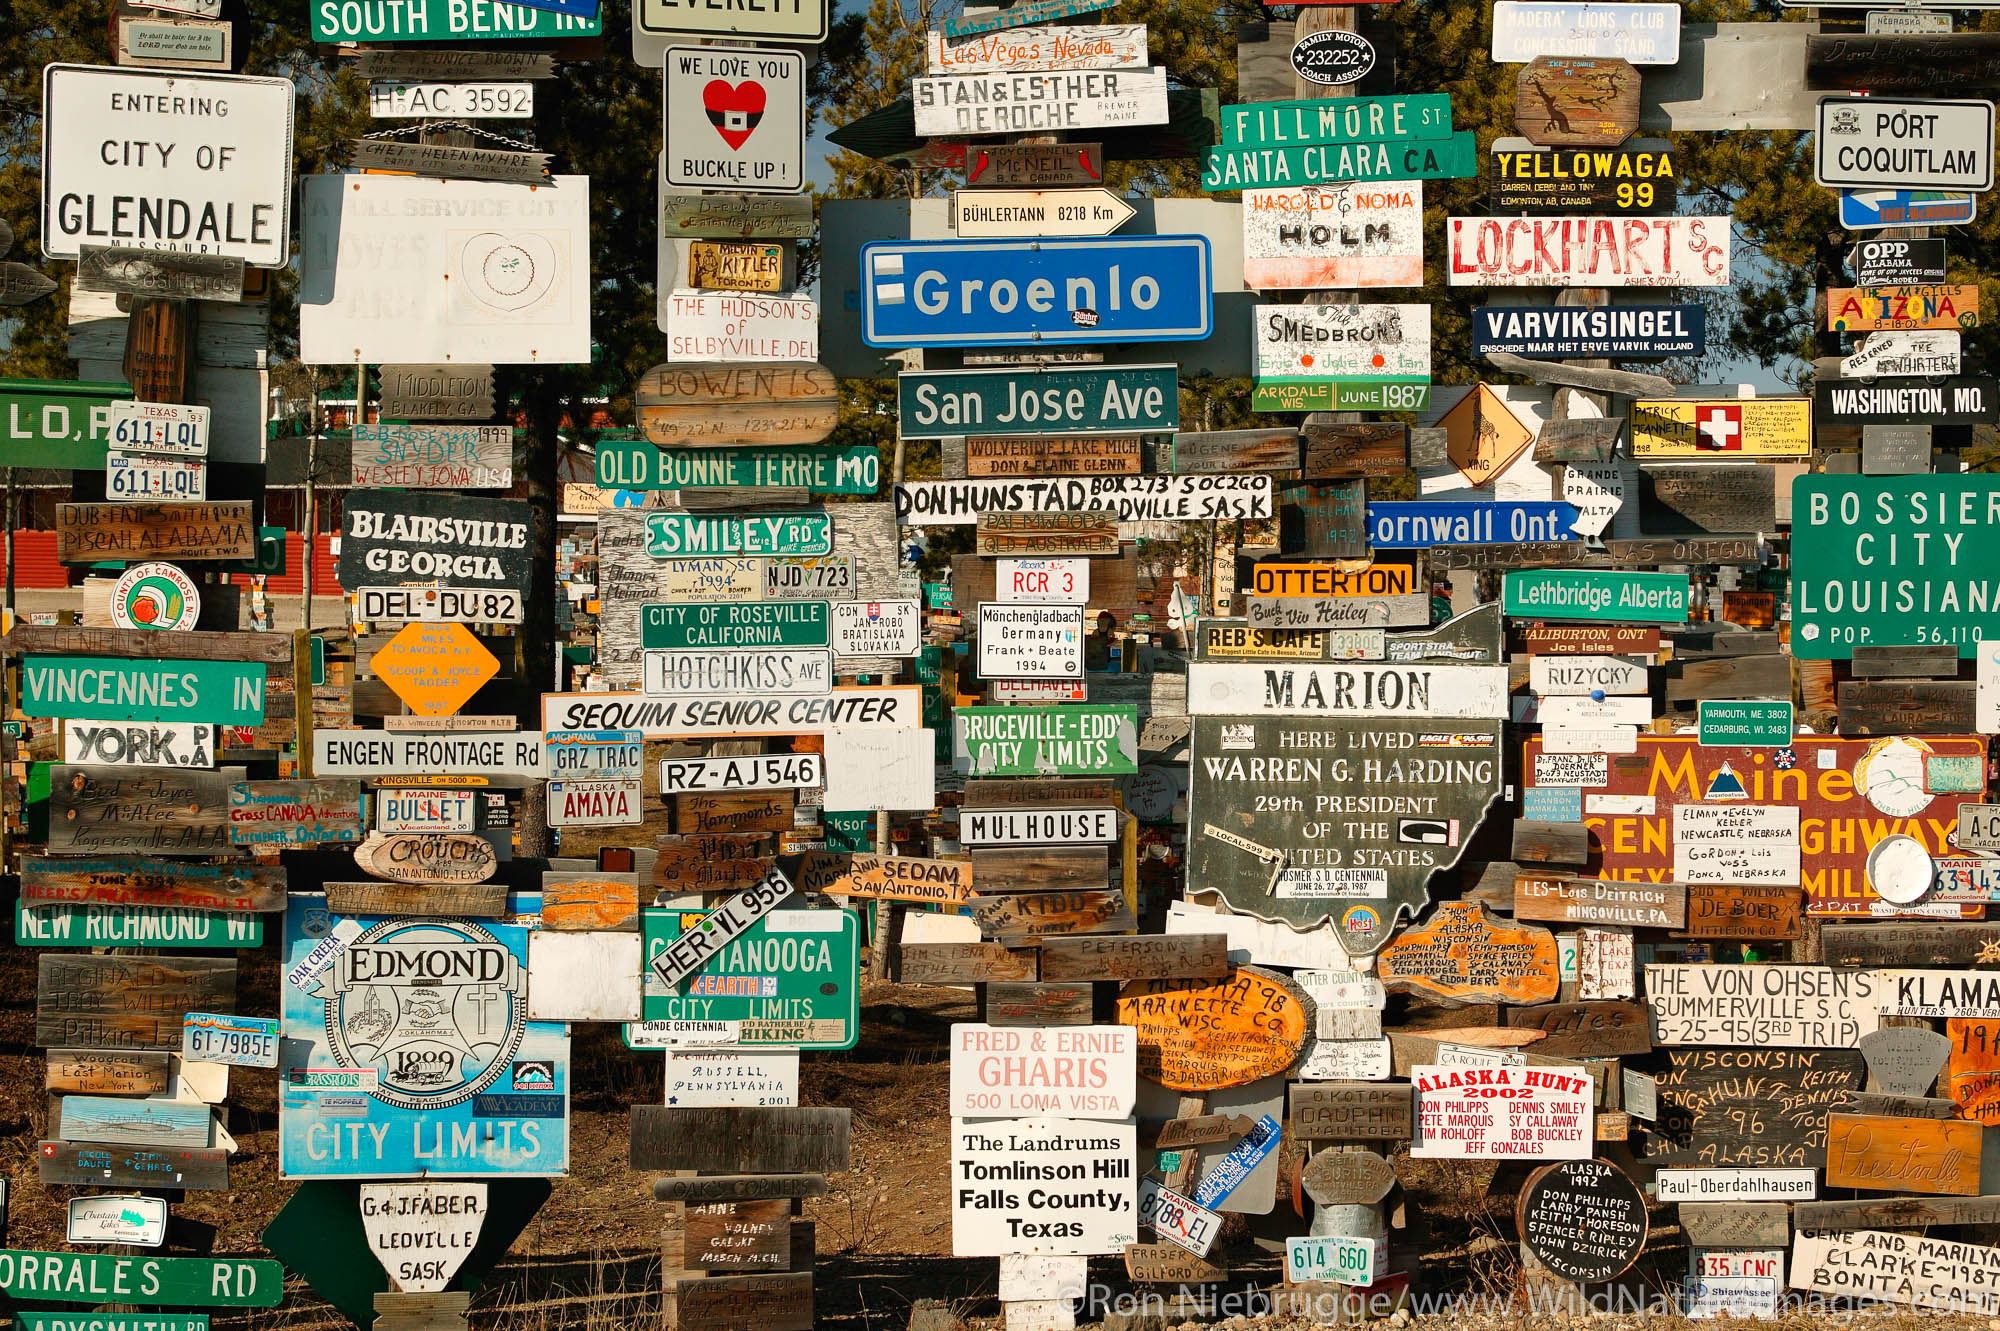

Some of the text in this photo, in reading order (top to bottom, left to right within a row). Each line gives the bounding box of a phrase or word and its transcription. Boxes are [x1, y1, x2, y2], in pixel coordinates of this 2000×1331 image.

[1877, 17, 1921, 26] NEBRASKA
[1298, 33, 1367, 51] FAMILY MOTOR
[680, 57, 790, 79] WE LOVE YOU
[1306, 50, 1360, 66] 232252
[1300, 65, 1367, 82] COACH ASSOC.
[112, 93, 229, 118] ENTERING
[1876, 114, 1938, 139] PORT
[100, 139, 236, 171] CITY OF
[1207, 144, 1440, 186] SANTA CLARA CA
[1838, 146, 1976, 174] COQUITLAM
[683, 159, 747, 180] BUCKLE
[1497, 153, 1674, 179] YELLOWAGA
[1616, 183, 1654, 209] 99
[58, 193, 273, 244] GLENDALE
[963, 205, 1114, 222] BÜHLERTANN 8218 Km
[1863, 242, 1909, 259] OPP
[1863, 259, 1912, 268] ALABAMA
[914, 264, 1160, 315] Groenlo
[1487, 310, 1689, 338] VARVIKSINGEL
[1479, 341, 1694, 353] ENSCHEDE NAAR HET ERVE VARVIK HOLLAND
[143, 407, 178, 418] TEXAS
[915, 379, 1163, 425] San Jose Ave
[116, 419, 202, 448] 611 LQL
[350, 510, 527, 549] BLAIRSVILLE
[365, 548, 505, 580] GEORGIA
[768, 566, 849, 587] NJD 723
[1518, 579, 1683, 613] Lethbridge Alberta
[649, 604, 819, 626] CITY OF ROSEVILLE
[983, 609, 1081, 626] Mönchengladbach
[686, 626, 783, 645] CALIFORNIA
[1002, 626, 1062, 642] Germany
[1208, 629, 1321, 648] REB'S CAFE
[987, 645, 1075, 656] Frank Beate
[1549, 642, 1614, 652] Joe Isles
[662, 655, 822, 689] HOTCHKISS AVE
[1016, 661, 1046, 671] 1994
[1547, 667, 1634, 686] RUZYCKY
[27, 667, 261, 712] VINCENNES IN
[1264, 669, 1432, 711] MARION
[561, 696, 898, 730] SEQUIM SENIOR CENTER
[1704, 710, 1748, 720] YARMOUTH,
[1767, 710, 1787, 719] 3802
[1279, 731, 1415, 749] HERE LIVED
[1704, 725, 1750, 736] CEDARBURG,
[1768, 725, 1787, 734] 2483
[327, 741, 539, 766] ENGEN FRONTAGE Rd
[1202, 756, 1492, 785] WARREN G. HARDING
[1255, 795, 1438, 814] 29th PRESIDENT
[971, 813, 1107, 840] MULHOUSE
[1302, 822, 1390, 839] OF THE
[1215, 830, 1264, 855] LOCAL 599
[1353, 849, 1434, 867] STATES
[347, 947, 506, 983] EDMOND
[668, 999, 814, 1020] CITY LIMITS
[642, 1020, 728, 1032] CONDE CENTENNIAL
[741, 1028, 805, 1040] HIKING
[962, 1031, 1125, 1054] FRED & ERNIE
[979, 1056, 1108, 1089] GHARIS
[1418, 1069, 1588, 1095] ALASKA HUNT
[966, 1093, 1120, 1111] 500 LOMA VISTA
[1463, 1087, 1534, 1098] 2002
[1418, 1101, 1586, 1113] DON PHILIPPS DENNIS SMILEY
[1418, 1115, 1579, 1128] PETE MARQUIS SY CALLAWAY
[306, 1121, 542, 1160] CITY LIMITS
[962, 1135, 1121, 1151] The Landrums
[1418, 1128, 1584, 1141] TIM ROHLOFF BOB BUCKLEY
[1464, 1142, 1544, 1154] JEFF GONZALES
[959, 1159, 1130, 1180] Tomlinson Hill
[1560, 1164, 1613, 1177] ALASKA
[1570, 1176, 1599, 1187] 1992
[959, 1189, 1131, 1212] Falls County,
[1540, 1201, 1627, 1220] LARRY PANSH
[1542, 1189, 1631, 1211] DON PHILIPPS
[1006, 1218, 1084, 1237] Texas
[1531, 1210, 1641, 1233] KEITH THORESON
[1528, 1221, 1636, 1248] SPENCER RIPLEY
[1531, 1235, 1628, 1261] JOHN DZURICK
[1539, 1247, 1612, 1279] WISCONSIN
[211, 1263, 257, 1297] RD
